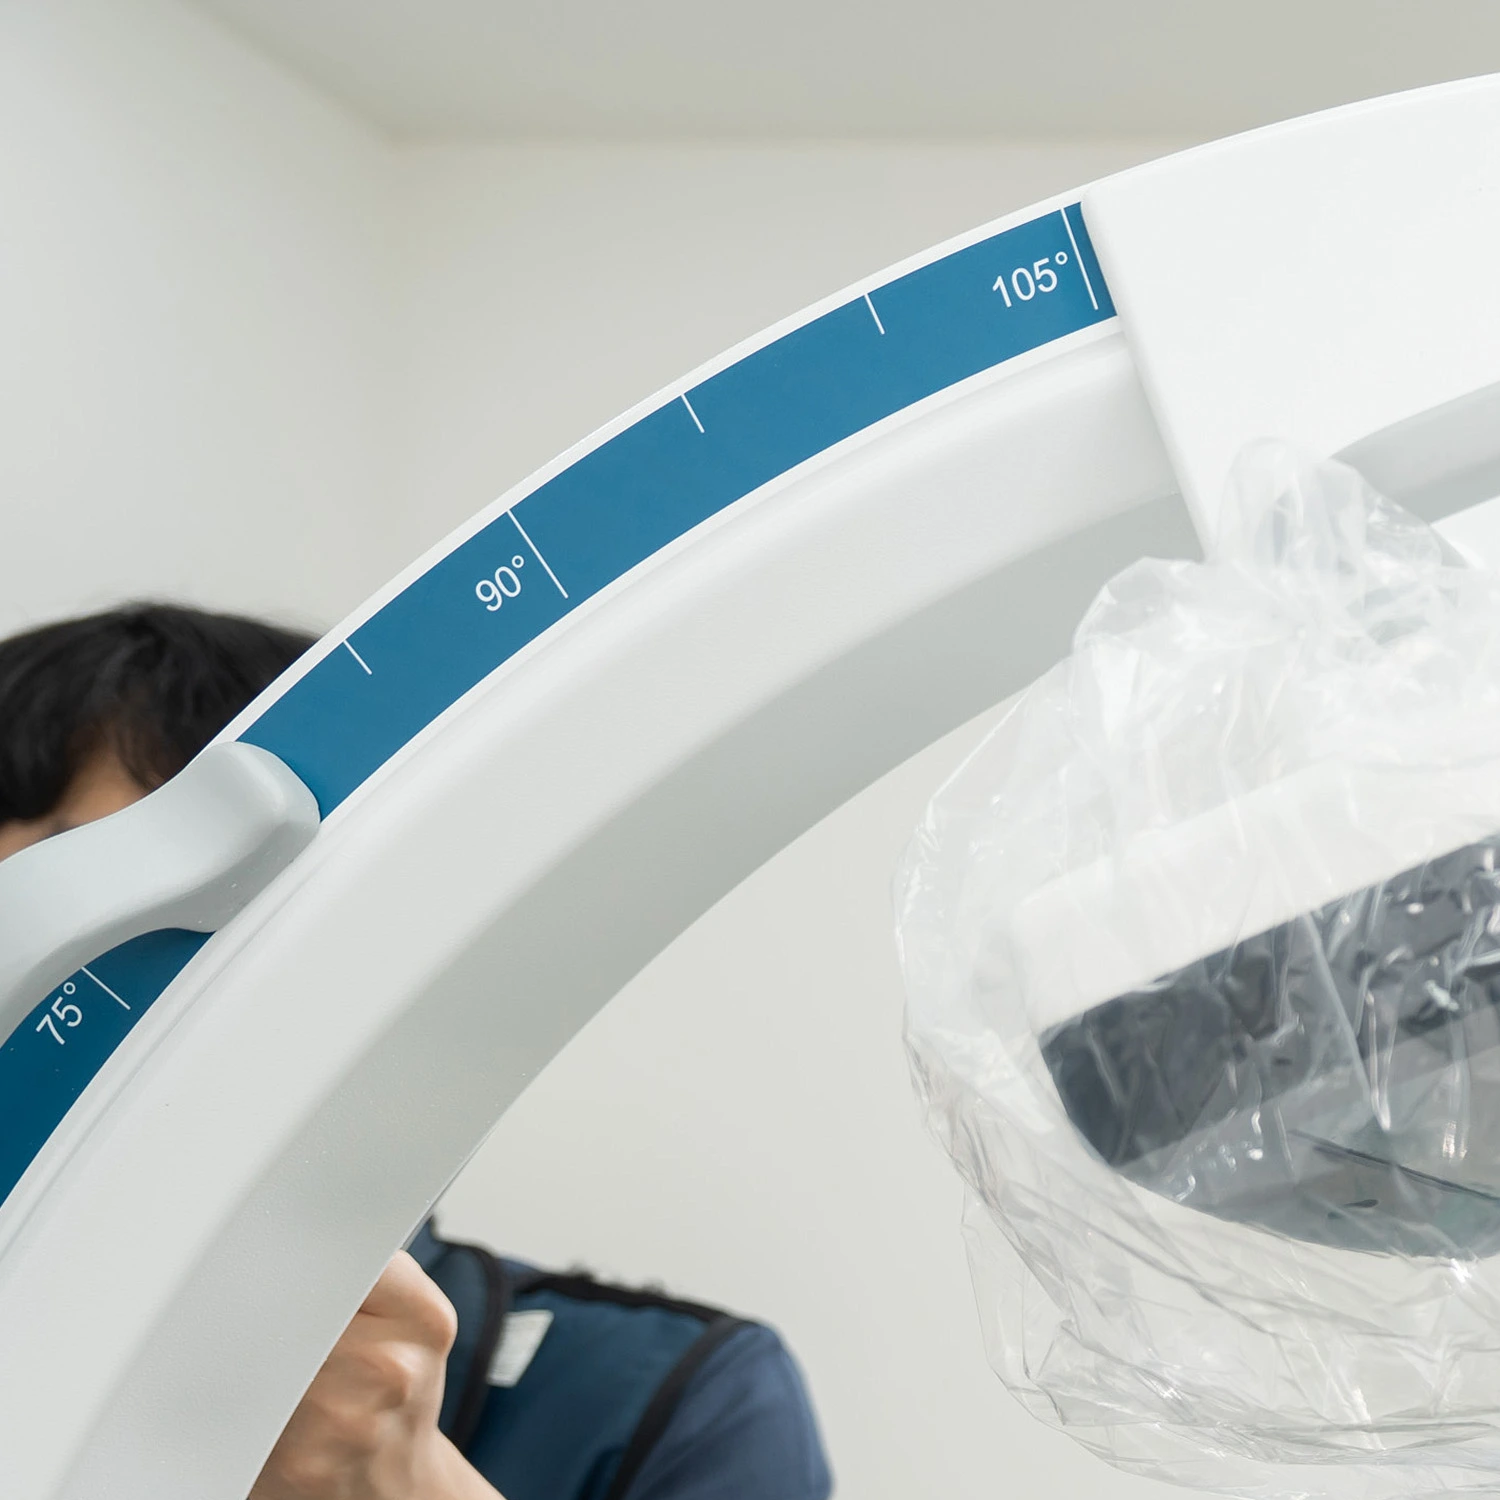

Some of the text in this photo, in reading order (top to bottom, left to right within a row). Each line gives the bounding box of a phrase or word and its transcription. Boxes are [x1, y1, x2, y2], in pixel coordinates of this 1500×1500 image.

[992, 251, 1069, 308] 105°
[475, 555, 525, 612] 90°
[35, 982, 83, 1045] 75°
